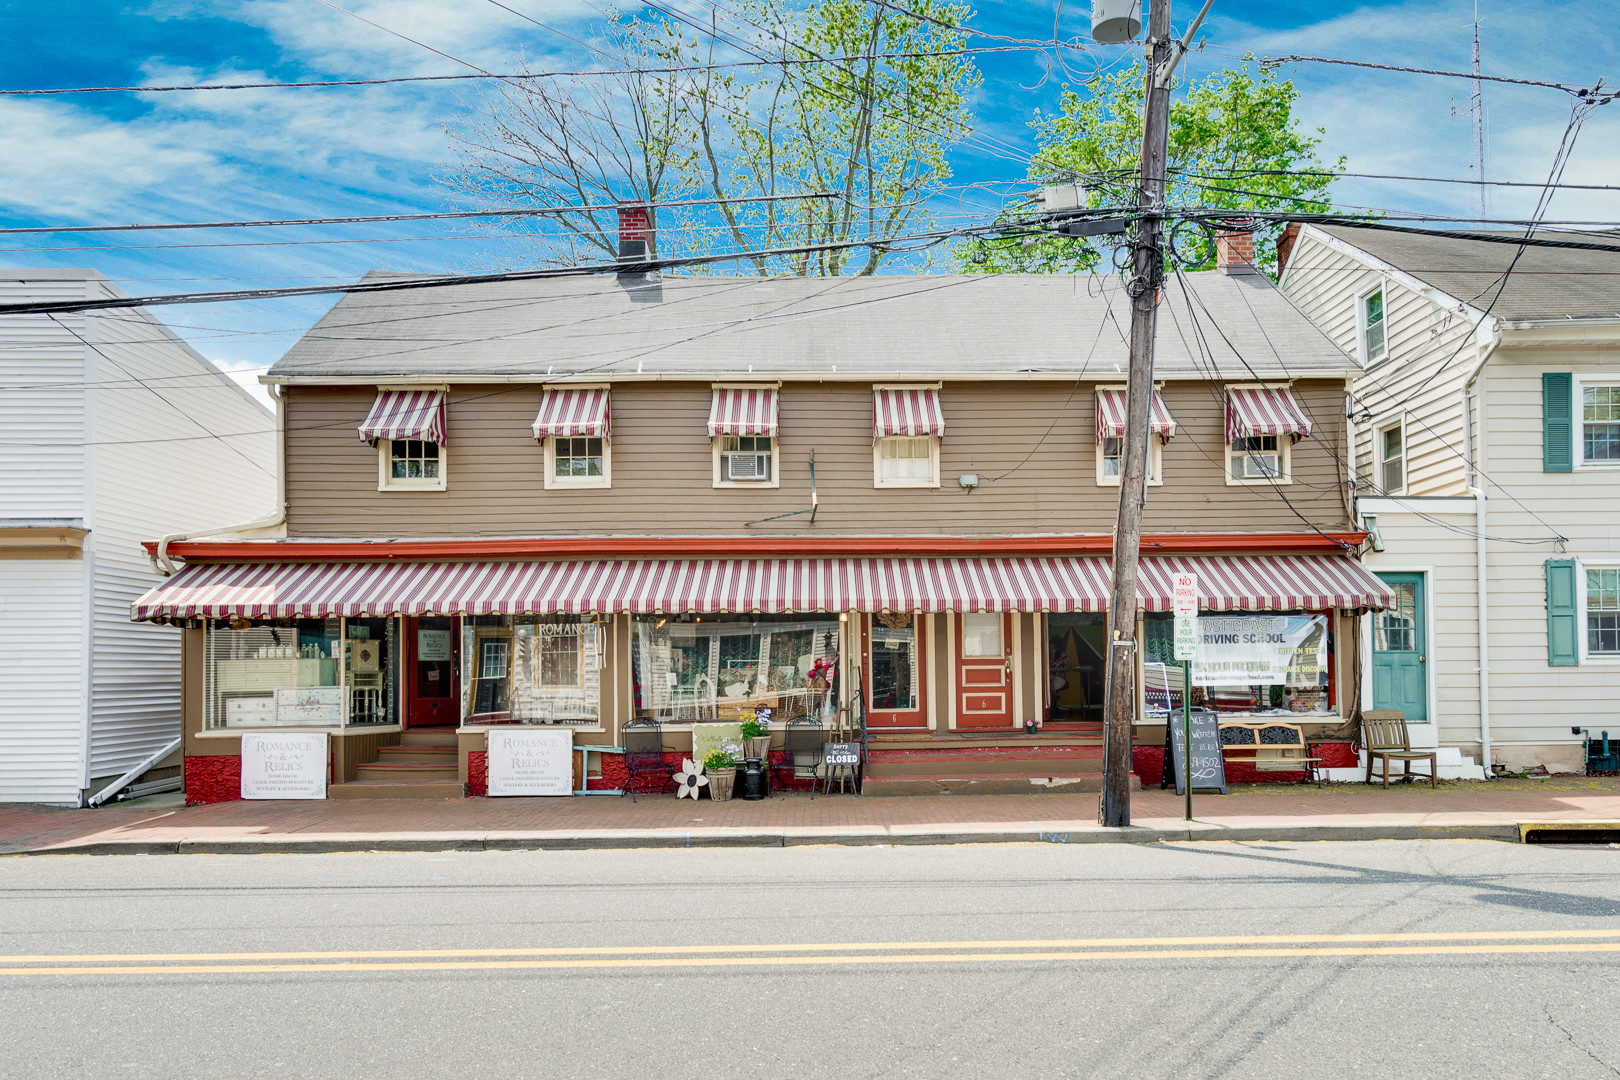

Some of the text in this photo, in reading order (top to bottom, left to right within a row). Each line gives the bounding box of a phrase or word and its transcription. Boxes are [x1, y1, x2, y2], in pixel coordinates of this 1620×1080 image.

[1179, 578, 1191, 586] NO
[1176, 588, 1195, 597] PARKING
[538, 623, 595, 635] ROMANCE
[1232, 618, 1277, 632] COAST
[1180, 628, 1193, 636] HOUR
[1177, 637, 1196, 645] PARKING
[1243, 633, 1287, 644] SCHOOL
[1273, 647, 1326, 655] WRITTEN TESTS
[1208, 662, 1231, 673] HOUR
[1232, 661, 1271, 672] PROGRAM
[981, 700, 987, 708] 6
[892, 714, 897, 722] 6
[256, 741, 313, 752] ROMANCE
[503, 738, 559, 749] ROMANCE
[279, 753, 287, 761] &
[526, 749, 533, 758] &
[512, 758, 550, 769] RELICS
[826, 755, 858, 763] CLOSED
[264, 761, 304, 773] RELICS
